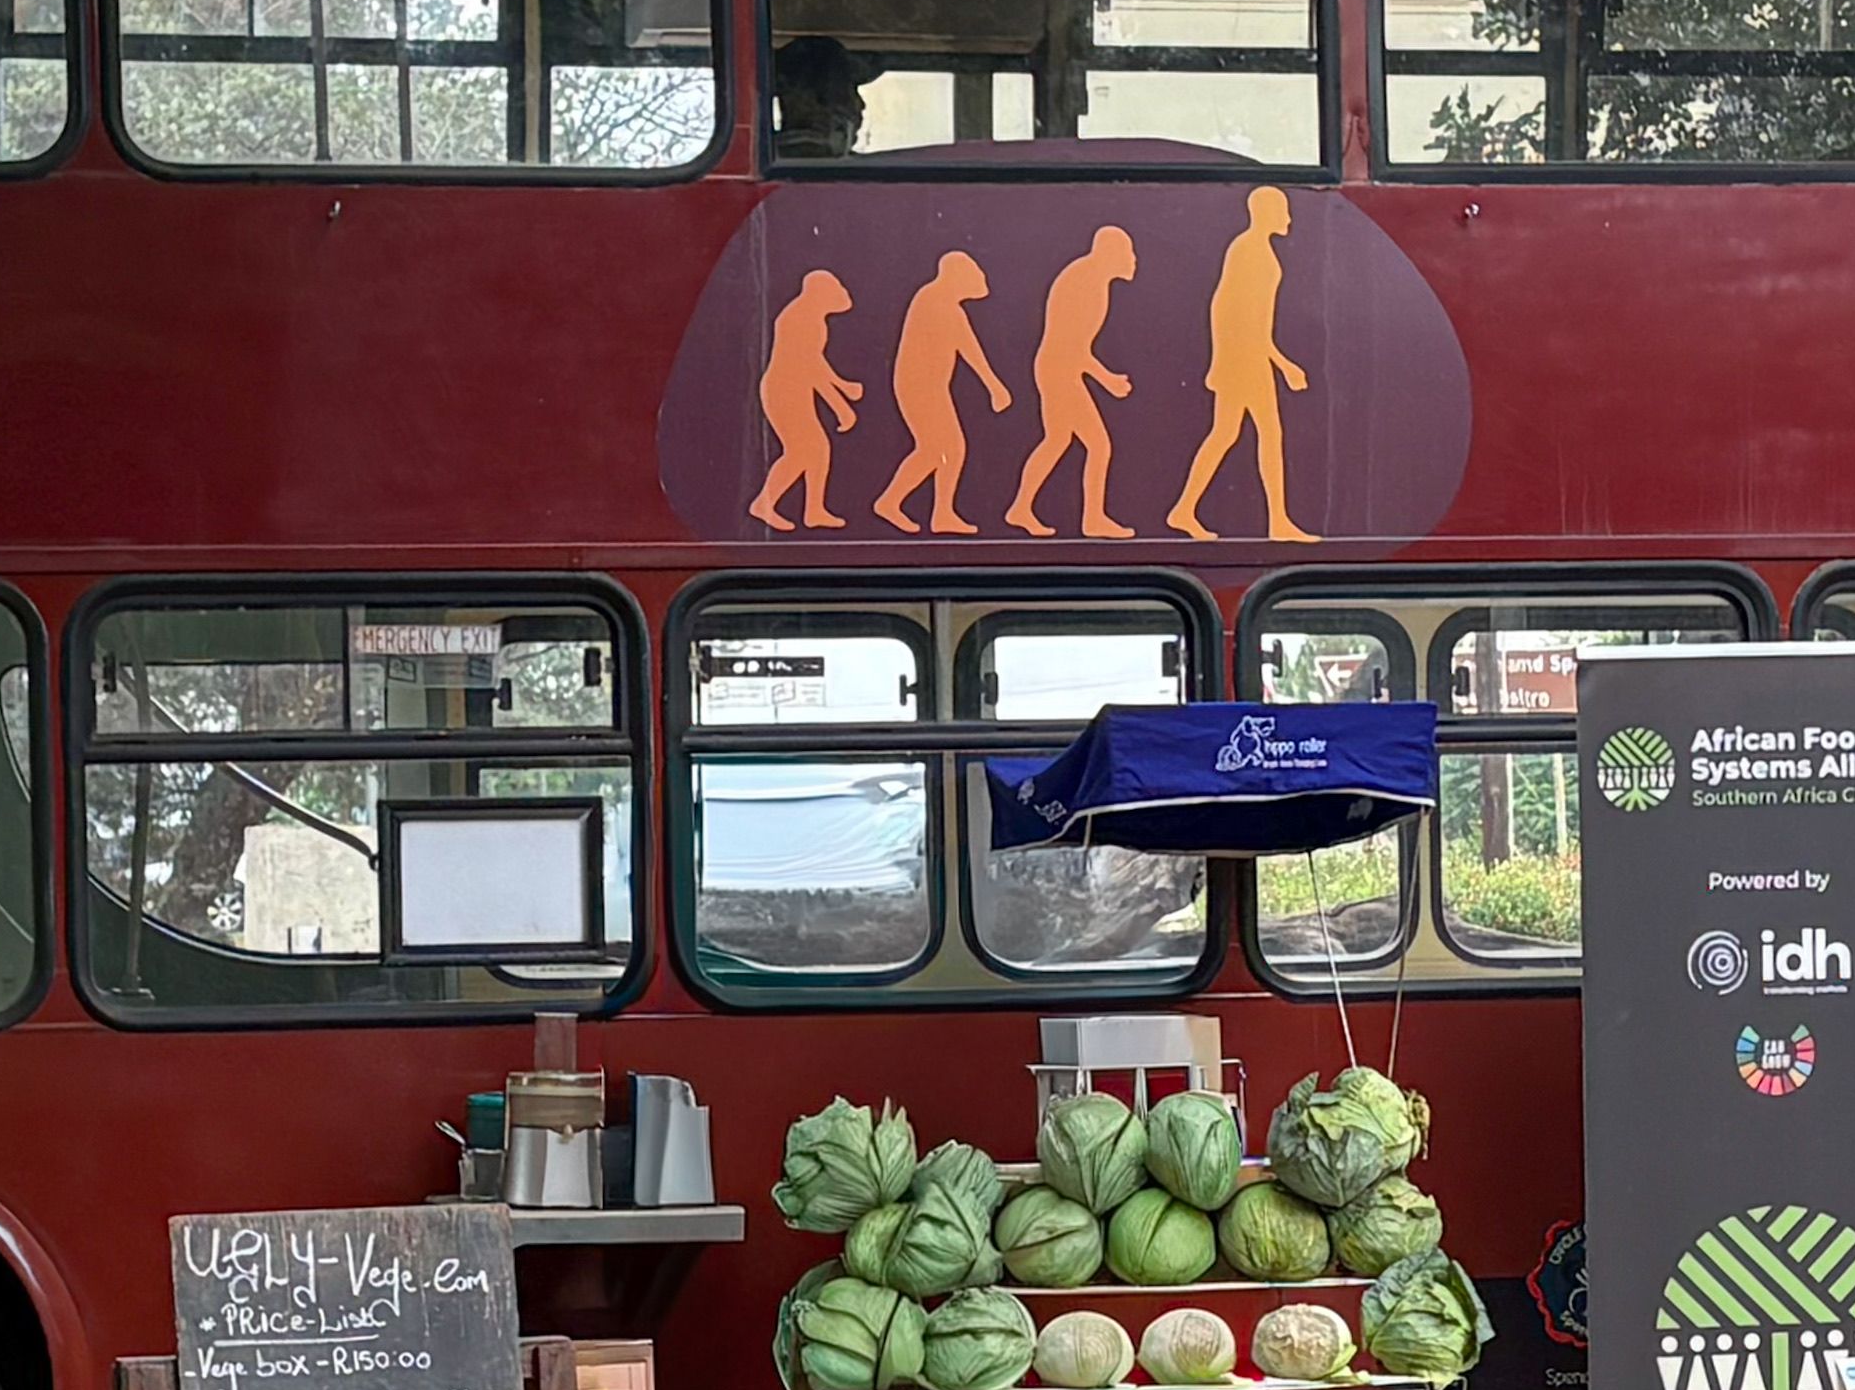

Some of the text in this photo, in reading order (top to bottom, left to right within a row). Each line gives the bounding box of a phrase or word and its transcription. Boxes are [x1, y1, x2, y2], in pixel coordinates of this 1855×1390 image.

[352, 625, 499, 654] EMERGENCY EXIT
[1690, 725, 1796, 753] African
[1691, 756, 1813, 786] Systems
[1692, 789, 1778, 807] Southern
[1782, 786, 1838, 804] Africa
[1707, 868, 1831, 893] Powered by
[1760, 926, 1853, 983] idh
[256, 1348, 311, 1377] box
